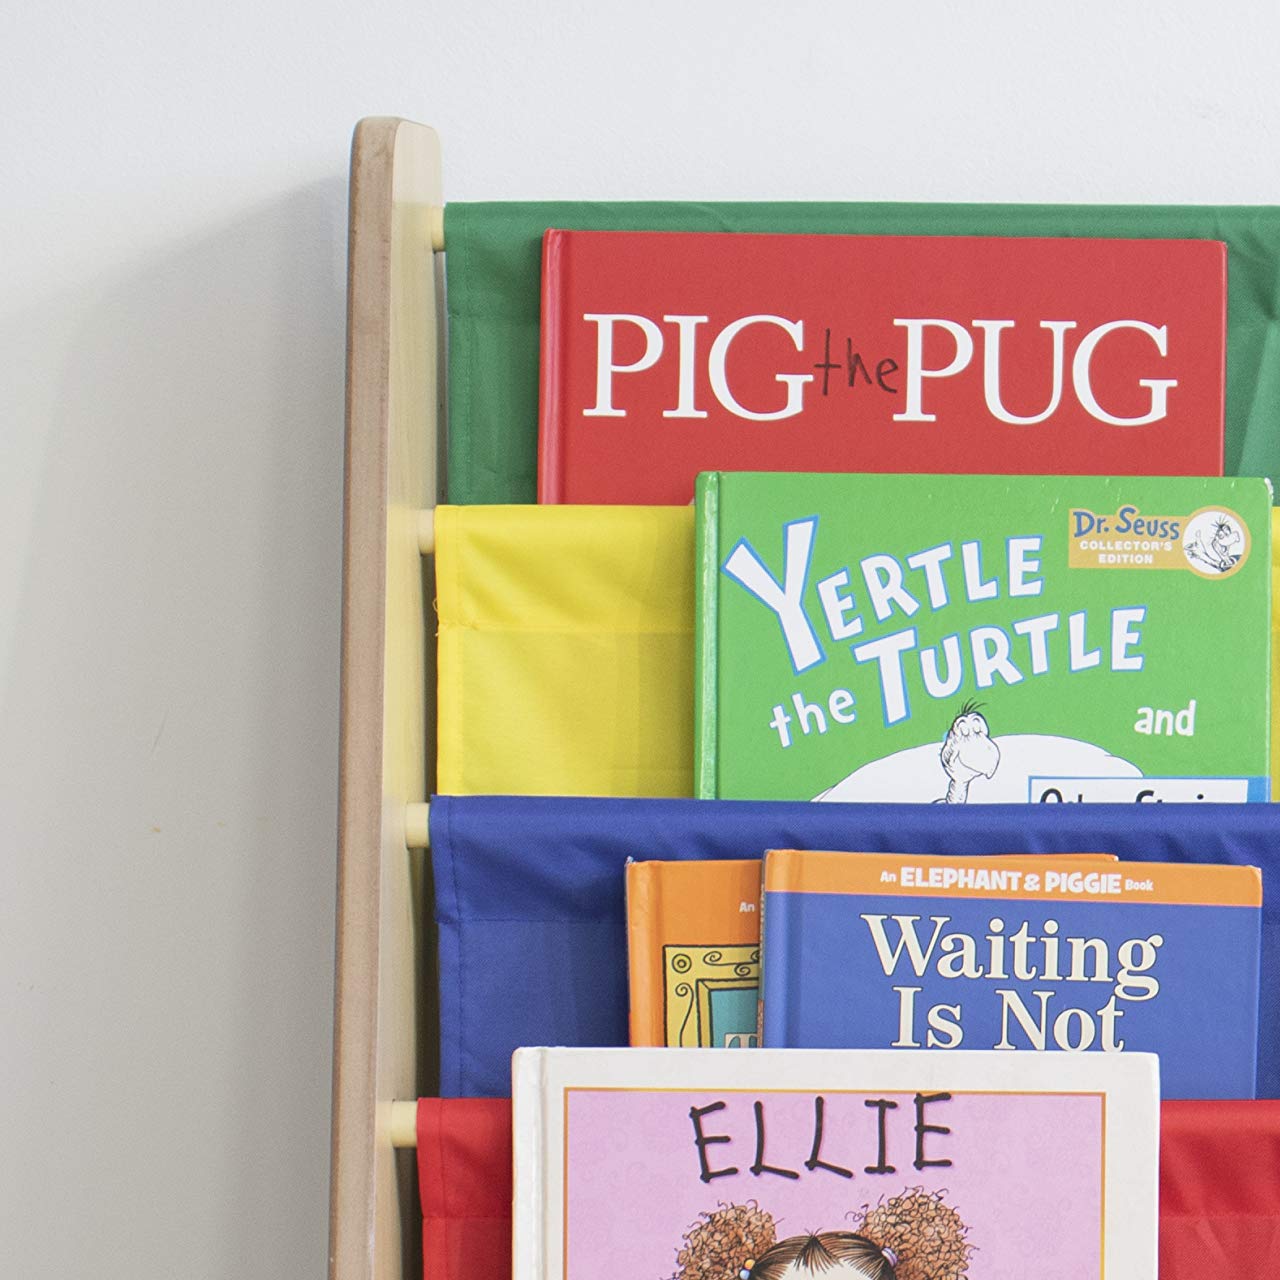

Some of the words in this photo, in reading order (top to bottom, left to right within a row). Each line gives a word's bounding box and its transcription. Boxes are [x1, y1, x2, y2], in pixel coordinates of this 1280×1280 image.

[582, 312, 815, 422] PIG
[813, 327, 899, 397] the
[893, 317, 1179, 428] PUG
[1072, 511, 1110, 538] Dr.
[1114, 506, 1181, 541] Seuss
[1079, 540, 1173, 552] COLLECTOR'S
[1097, 553, 1154, 565] EDITION
[720, 514, 1046, 676] YERTLE
[769, 687, 857, 749] the
[851, 606, 1148, 728] TURTLE
[1133, 700, 1197, 737] and
[879, 870, 897, 883] An
[900, 866, 1022, 892] ELEPHANT
[1023, 872, 1041, 892] &
[1044, 871, 1122, 894] PIGGIE
[1124, 879, 1154, 892] Book
[738, 901, 755, 914] An
[859, 913, 1165, 1001] Waiting
[890, 985, 965, 1050] Is
[993, 988, 1125, 1051] Not
[688, 1091, 954, 1185] ELLIE
